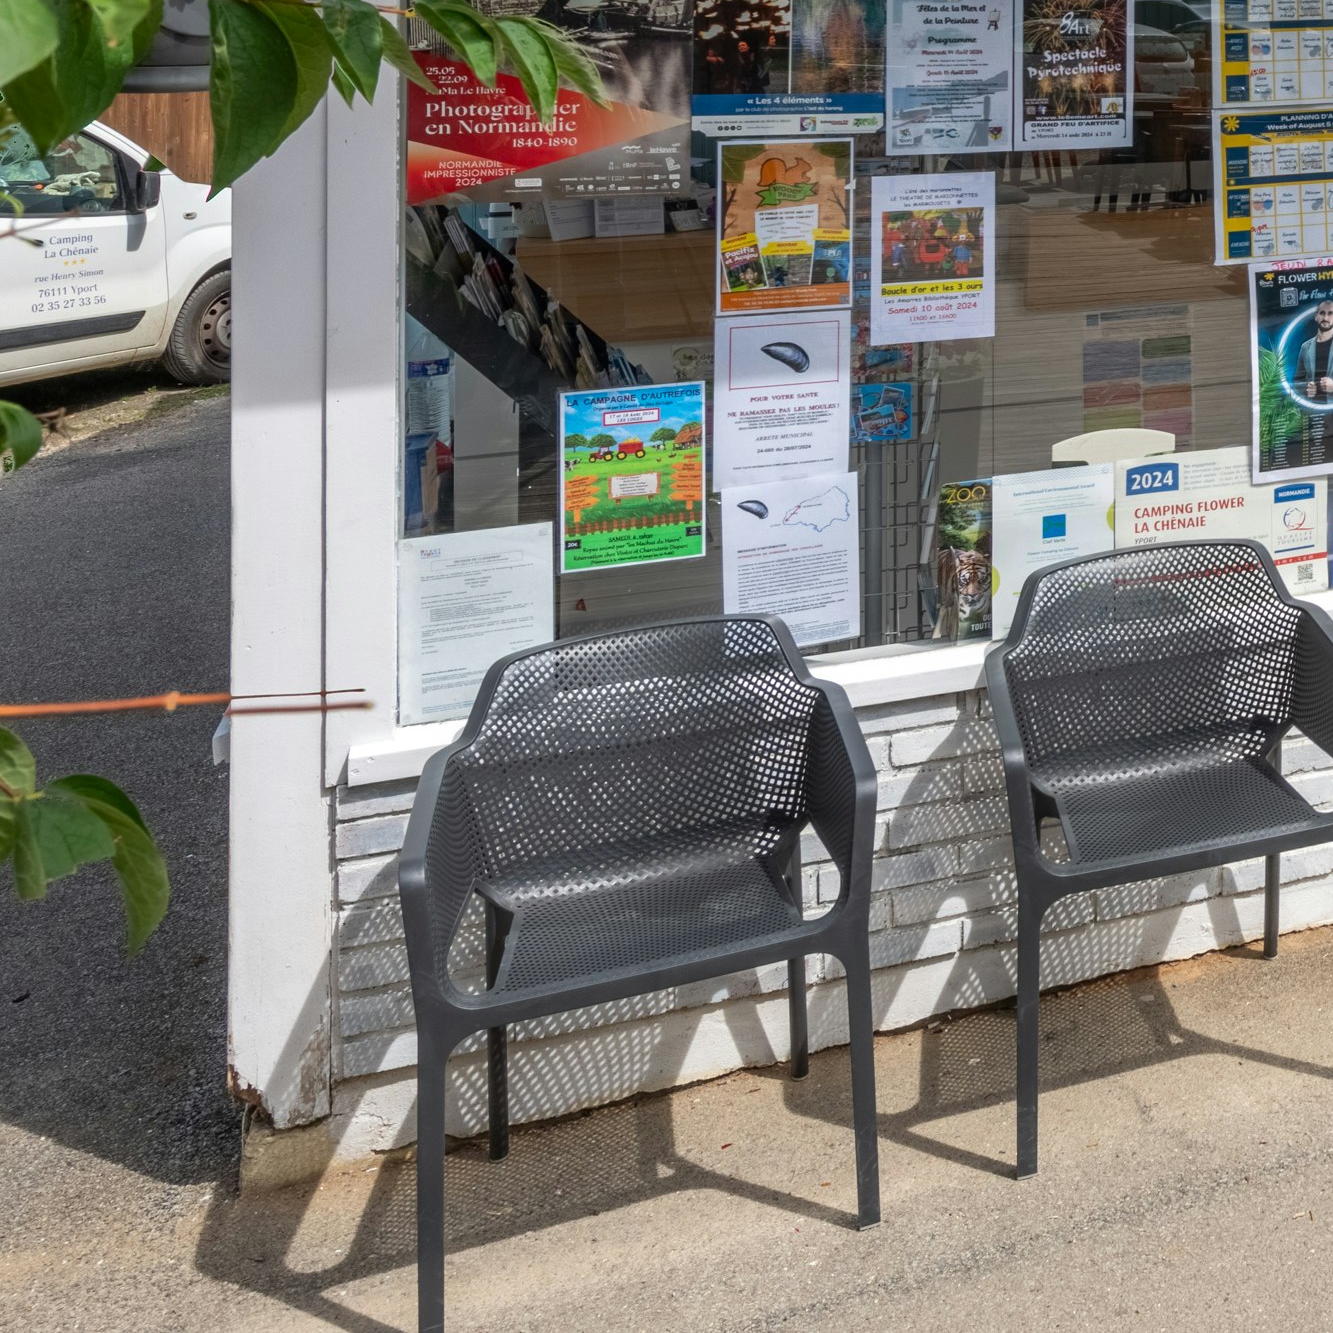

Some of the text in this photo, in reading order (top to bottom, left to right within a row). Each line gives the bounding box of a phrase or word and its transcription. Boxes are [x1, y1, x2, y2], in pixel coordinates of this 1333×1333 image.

[927, 37, 977, 45] Programme
[1043, 47, 1107, 64] Spectacle
[425, 67, 455, 75] 25.05
[1027, 60, 1122, 80] Pyrotechnique
[438, 75, 468, 84] 22.09
[460, 86, 506, 95] Le Havre
[782, 96, 824, 104] éléments
[425, 100, 580, 121] Photograpier
[1281, 114, 1320, 122] PLANNING
[425, 117, 577, 135] en Normandie
[1299, 122, 1325, 130] August
[512, 137, 577, 148] 1840-1890
[455, 178, 482, 186] 2024
[49, 235, 93, 246] Camping
[44, 244, 99, 259] La Chênaie
[724, 246, 755, 258] Pacifix
[34, 268, 104, 283] rue Henry Simon
[1278, 273, 1317, 284] FLOWER
[38, 283, 98, 298] 76111 Yport
[881, 287, 907, 296] Boucle
[911, 285, 927, 294] d'or
[924, 294, 958, 302] Bibliothèque
[31, 295, 107, 314] 02 35 27 33 56
[888, 306, 918, 315] Samedi
[935, 303, 952, 312] août
[567, 399, 578, 407] LA
[583, 395, 636, 406] CAMPAGNE
[641, 389, 700, 400] D'AUTREFOIS
[1131, 470, 1174, 490] 2024
[946, 485, 986, 504] ZOO
[1278, 488, 1311, 498] NORMANDIE
[1134, 497, 1244, 519] CAMPING FLOWER
[1134, 516, 1206, 534] LA CHÊNAIE
[1134, 536, 1157, 545] YPORT
